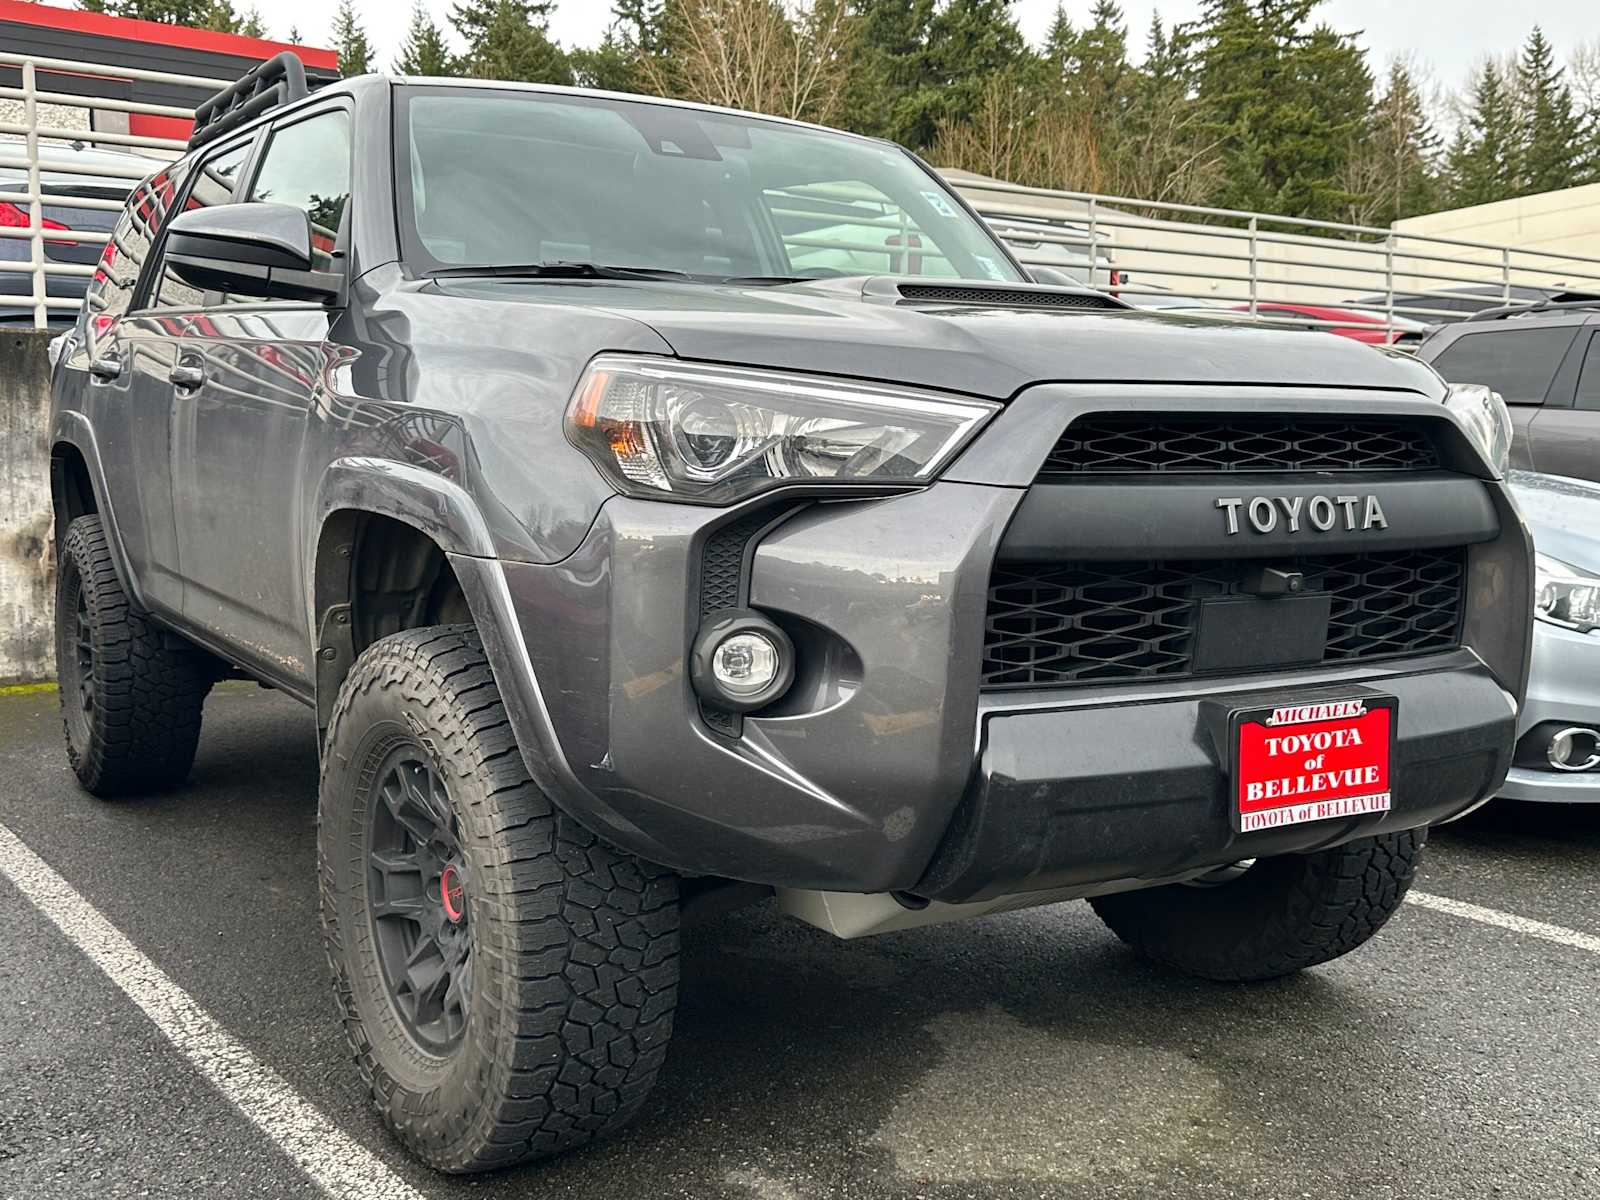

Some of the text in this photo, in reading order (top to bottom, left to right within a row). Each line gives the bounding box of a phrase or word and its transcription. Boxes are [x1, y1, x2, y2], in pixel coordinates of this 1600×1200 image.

[1216, 495, 1388, 535] TOYOTA
[1274, 701, 1361, 723] MICHAELS
[1264, 727, 1363, 757] TOYOTA
[1304, 754, 1325, 770] of
[1246, 765, 1379, 801] BELLEVUE
[1244, 794, 1389, 831] TOYOTA of BELLEVUE
